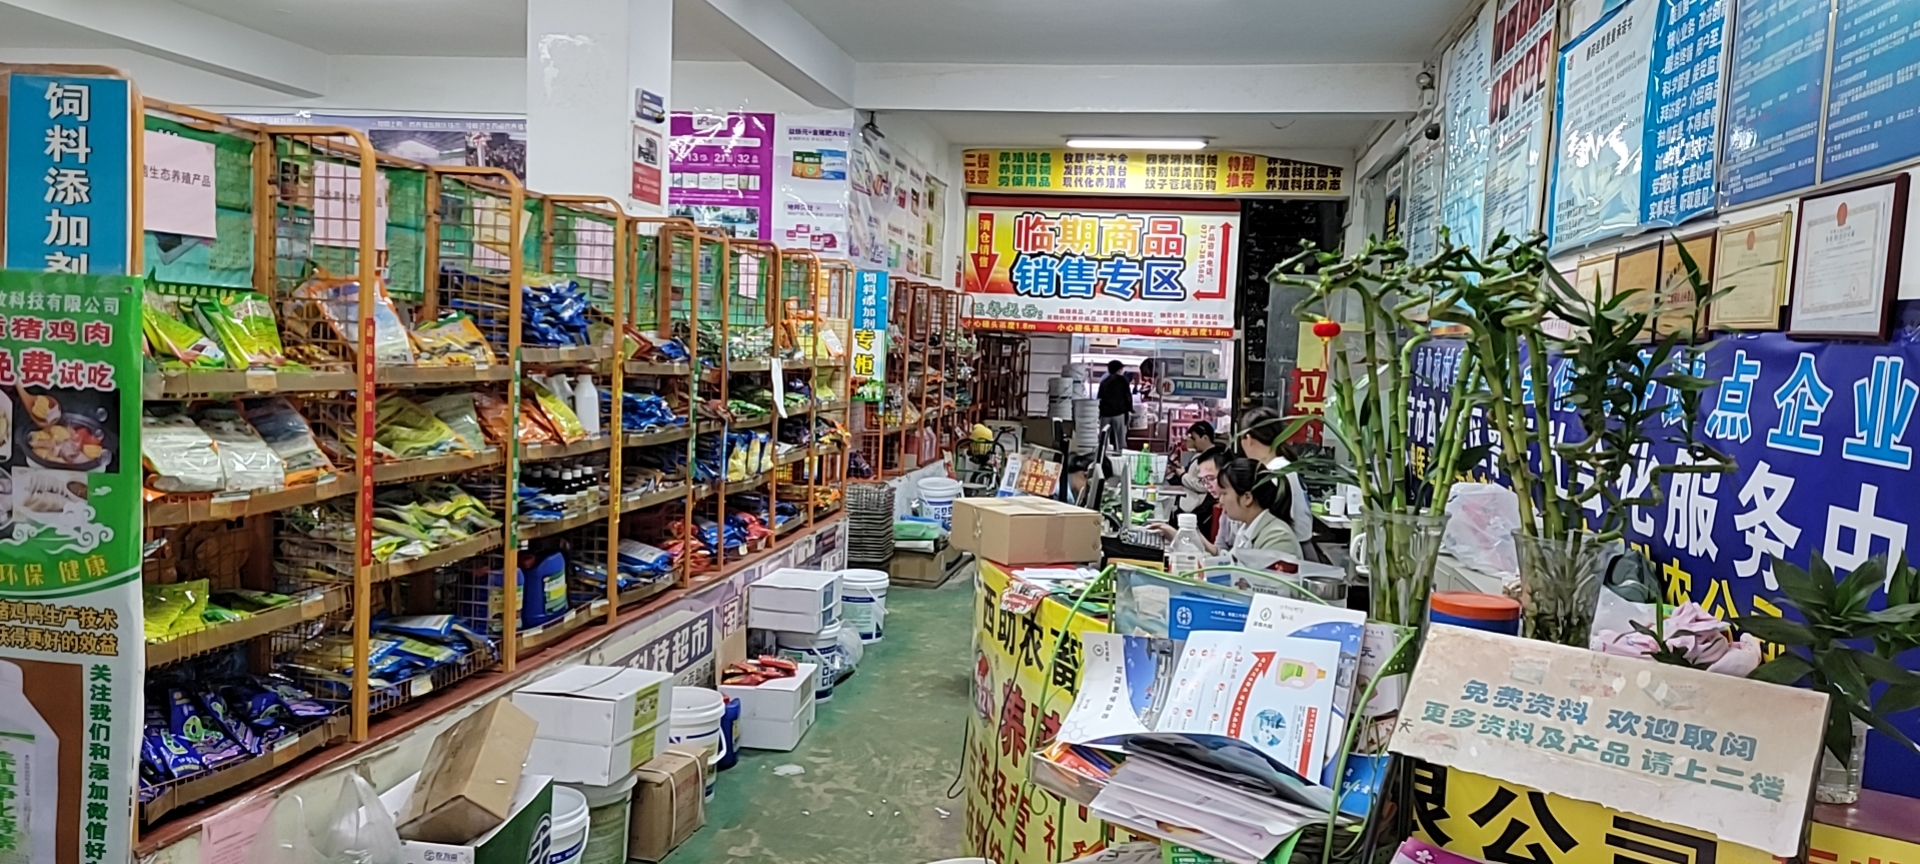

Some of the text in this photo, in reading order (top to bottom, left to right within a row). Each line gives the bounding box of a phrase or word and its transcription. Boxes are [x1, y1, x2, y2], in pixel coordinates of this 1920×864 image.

[964, 153, 989, 168] 二楼
[999, 152, 1051, 164] 养殖设备
[1064, 152, 1128, 164] 牧草种子大全
[1227, 155, 1256, 171] 特别
[963, 170, 989, 185] 经营
[998, 176, 1051, 188] 劳保用品
[1226, 173, 1255, 188] 推荐
[1266, 178, 1342, 191] 养殖科技杂志
[1648, 195, 1677, 221] 实事求是
[978, 219, 991, 268] 清仓销售
[1014, 212, 1186, 257] 临期商品
[1012, 255, 1187, 300] 销售专区
[862, 273, 877, 329] 饲料添加剂
[0, 316, 113, 345] 猪鸡肉
[854, 330, 876, 376] 专柜
[0, 554, 109, 586] 环保 健康
[1460, 679, 1758, 762] 免费资料 欢迎取阅
[84, 664, 112, 864] 关注我们和添加微信好
[1421, 700, 1786, 803] 更多资料及产品 请上二楼
